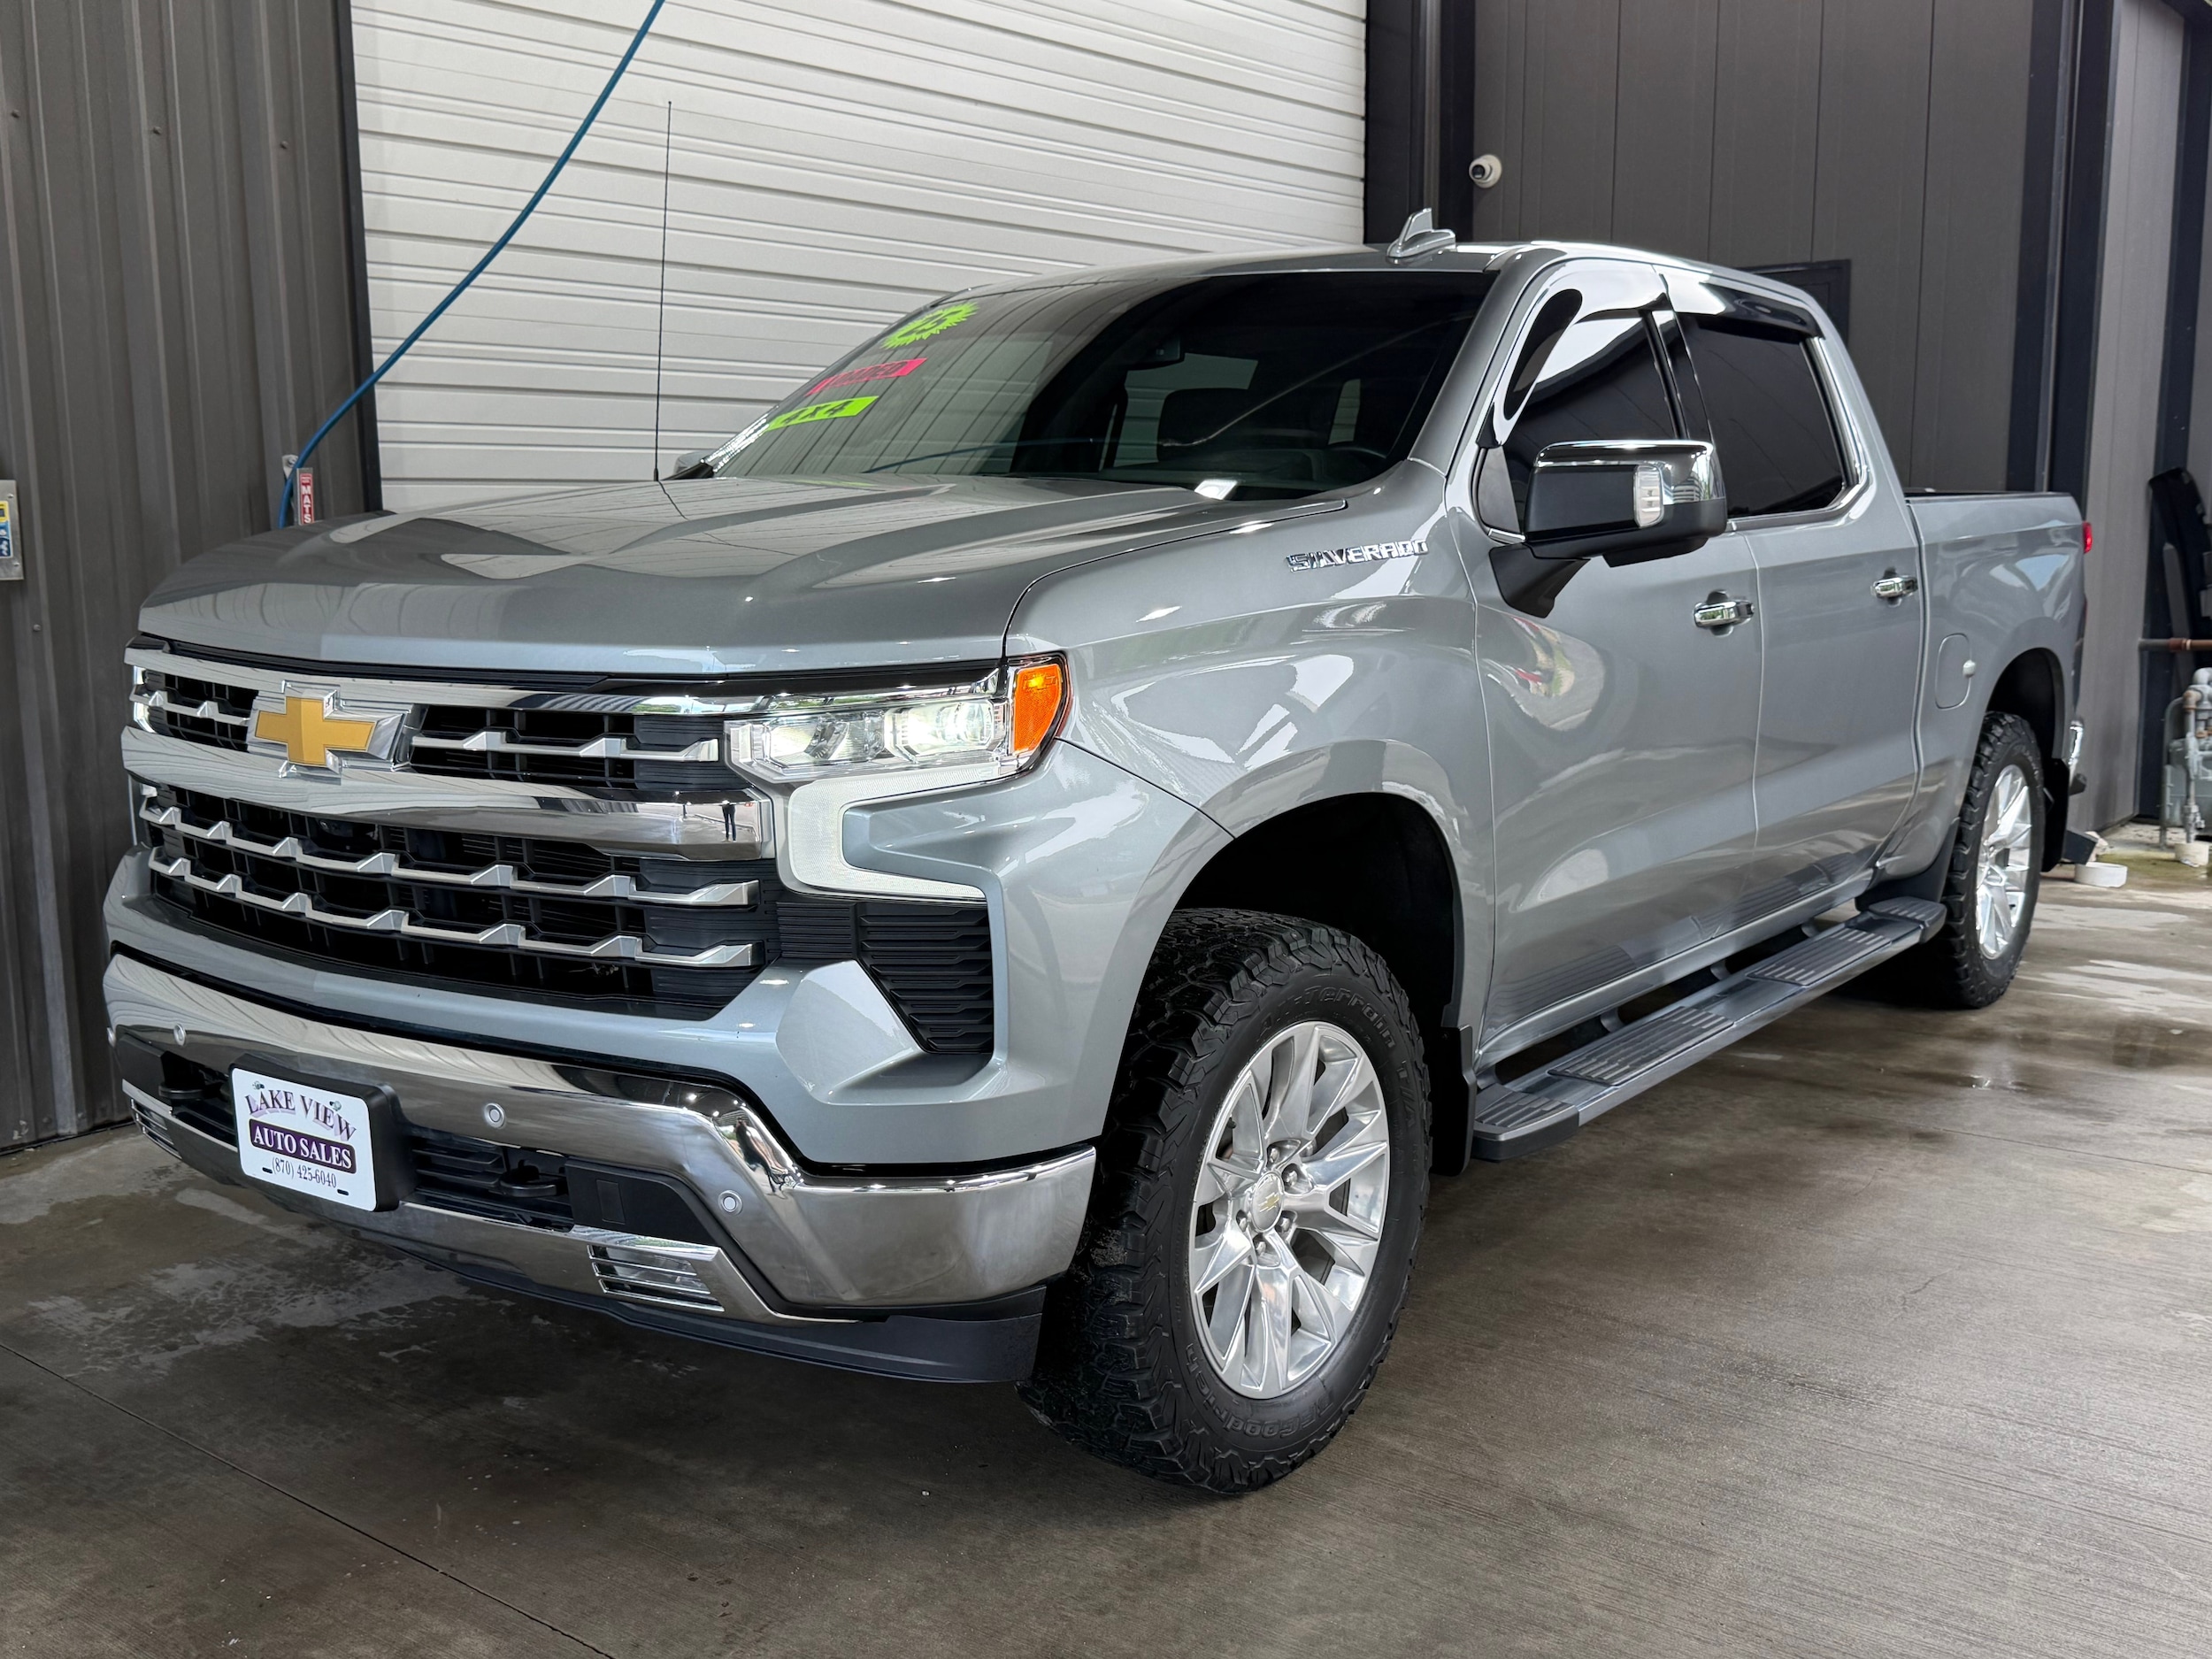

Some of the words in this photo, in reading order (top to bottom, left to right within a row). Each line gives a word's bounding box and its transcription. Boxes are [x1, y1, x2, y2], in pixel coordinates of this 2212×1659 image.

[302, 486, 311, 524] MATS
[1286, 539, 1429, 572] SILVERADO
[245, 1089, 296, 1117] LAKE
[300, 1094, 357, 1141] VIEW
[253, 1125, 296, 1154] AUTO
[300, 1138, 352, 1169] SALES
[272, 1157, 295, 1179] (870)
[296, 1164, 337, 1188] 425-6040
